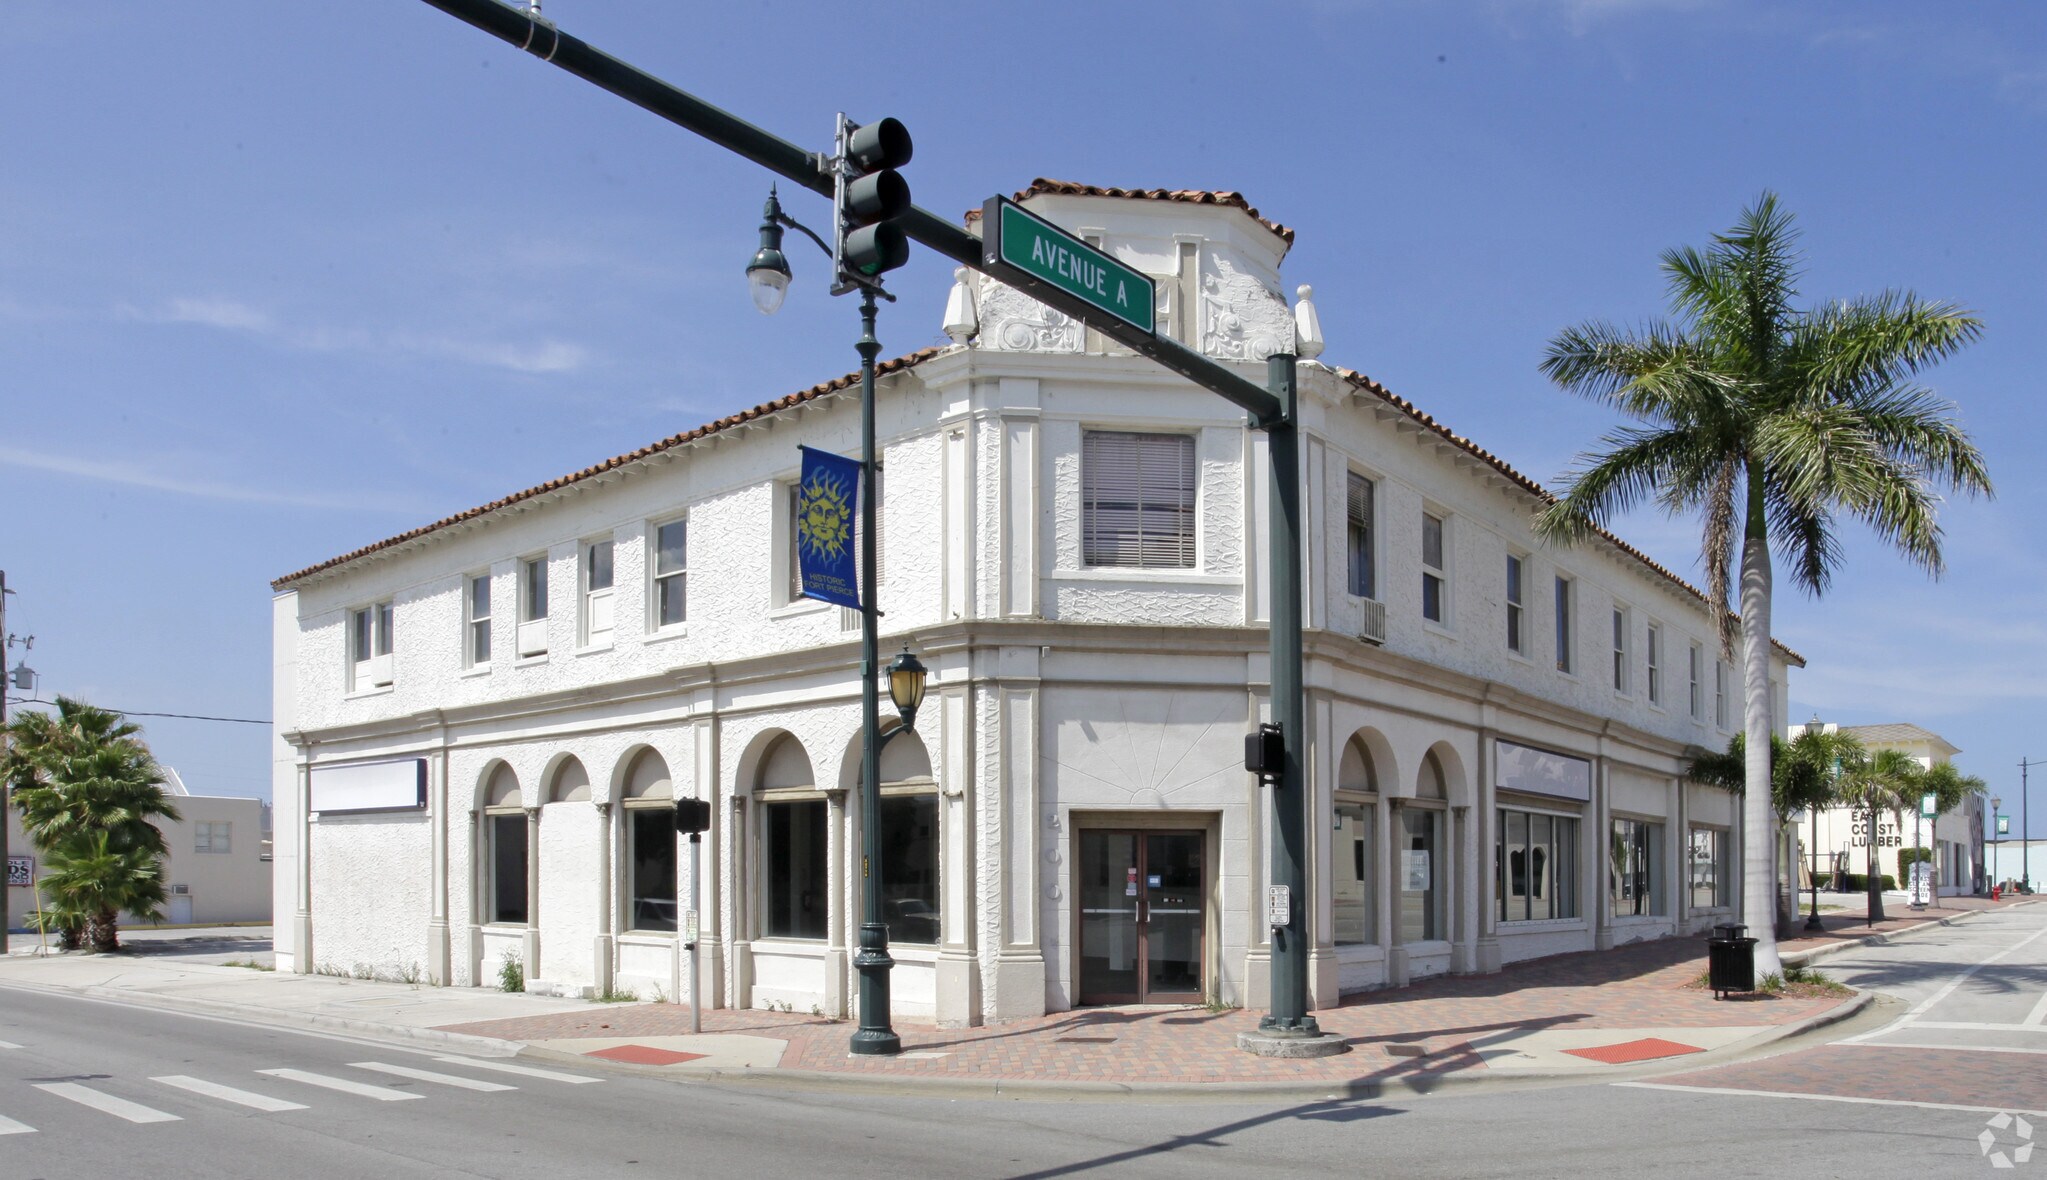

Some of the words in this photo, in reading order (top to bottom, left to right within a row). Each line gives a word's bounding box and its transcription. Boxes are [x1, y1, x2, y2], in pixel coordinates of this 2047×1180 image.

[1032, 235, 1106, 297] AVENUE
[1116, 280, 1128, 308] A
[809, 573, 846, 587] HISTORIC
[804, 580, 825, 590] FORT
[826, 584, 854, 597] PIERCE
[1851, 811, 1883, 822] EAT
[1851, 823, 1894, 835] COST
[1851, 836, 1902, 847] LUBER
